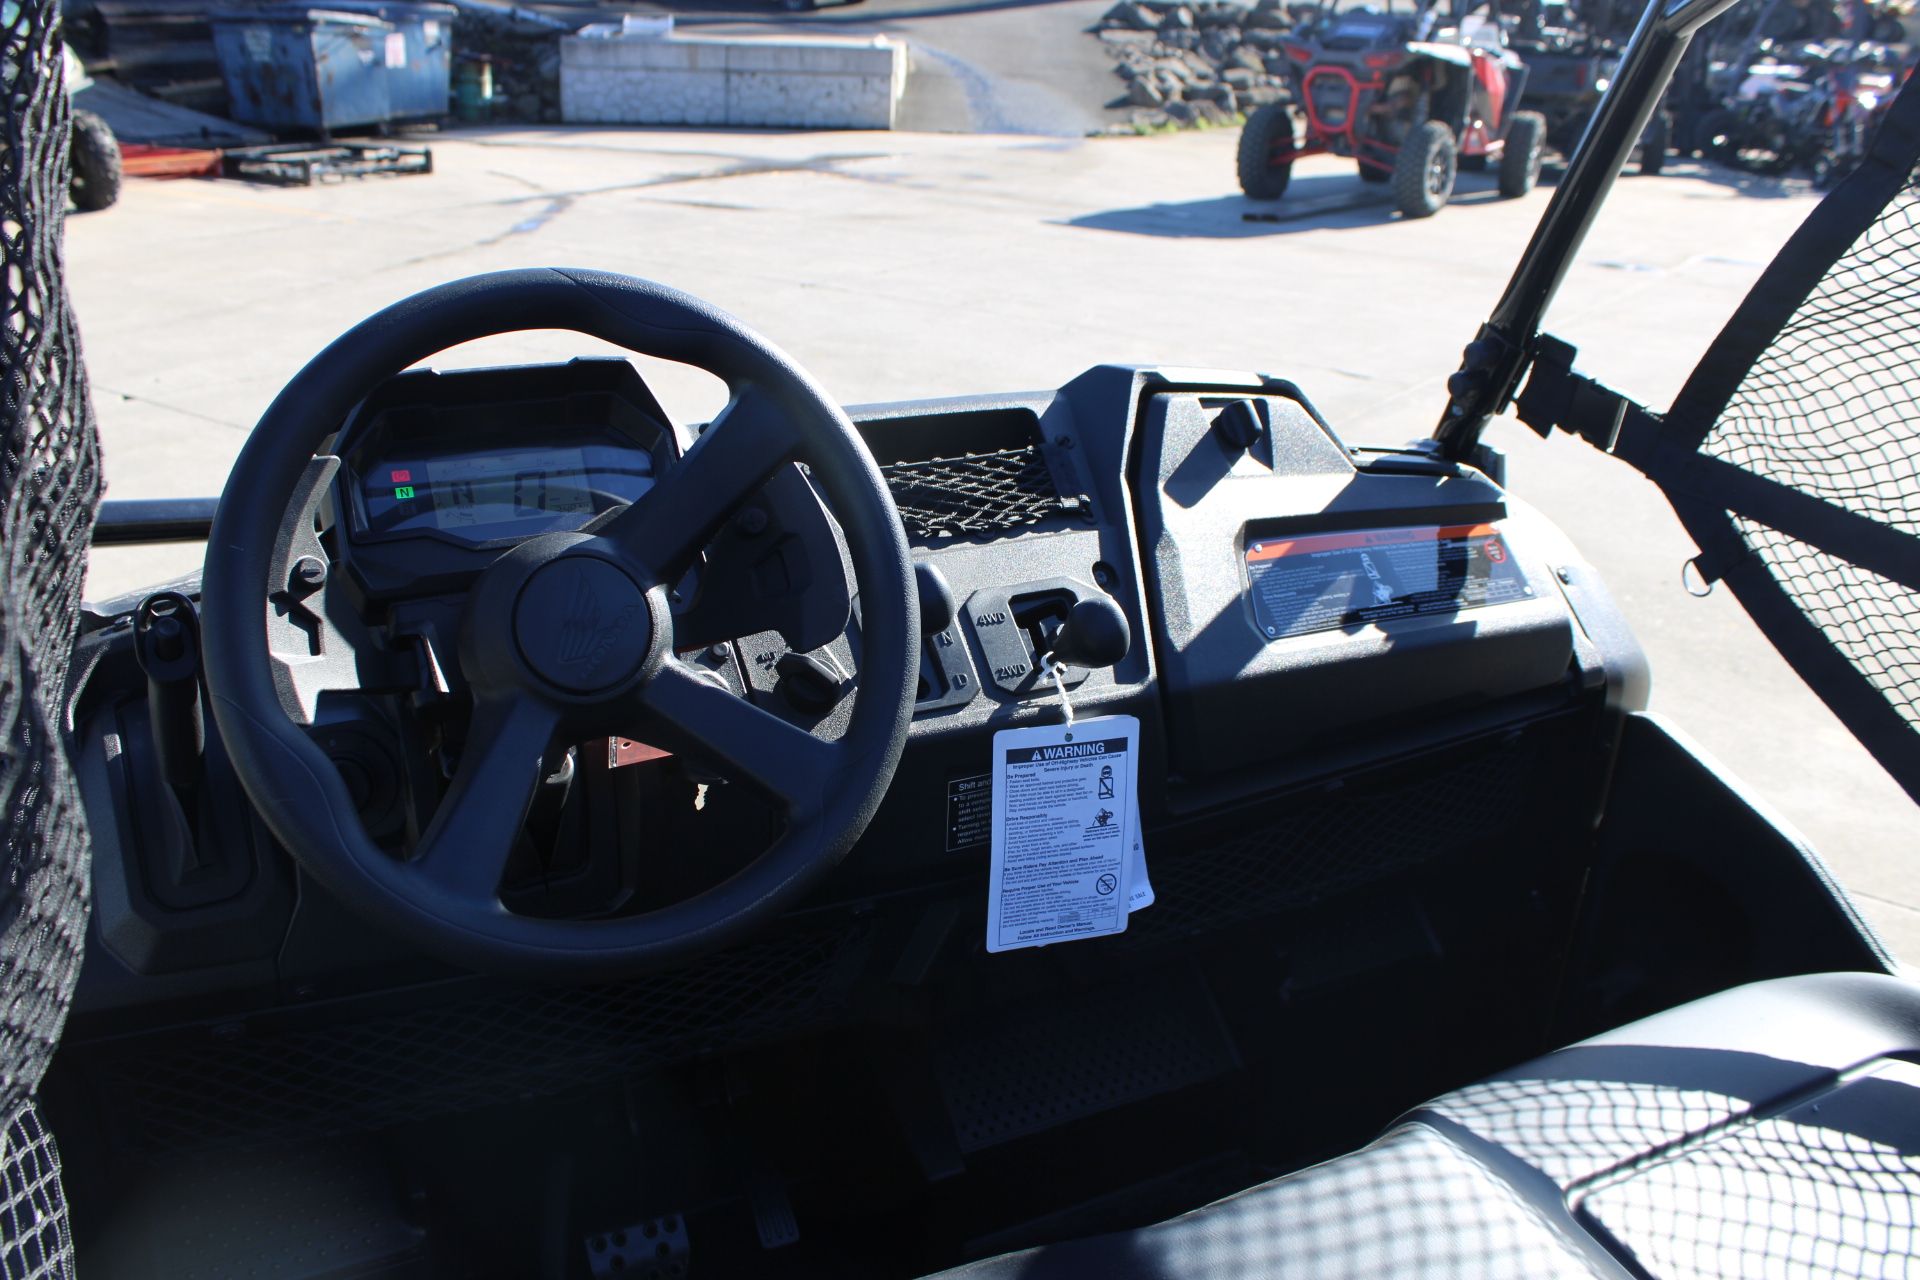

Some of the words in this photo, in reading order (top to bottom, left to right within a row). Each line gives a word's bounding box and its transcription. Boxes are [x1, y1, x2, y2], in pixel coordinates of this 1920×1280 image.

[400, 488, 410, 498] N
[978, 612, 1006, 626] 4WD
[940, 630, 955, 646] N
[998, 663, 1026, 680] 2WD
[955, 673, 969, 688] D
[1043, 742, 1105, 760] WARNING
[959, 782, 975, 791] Shift
